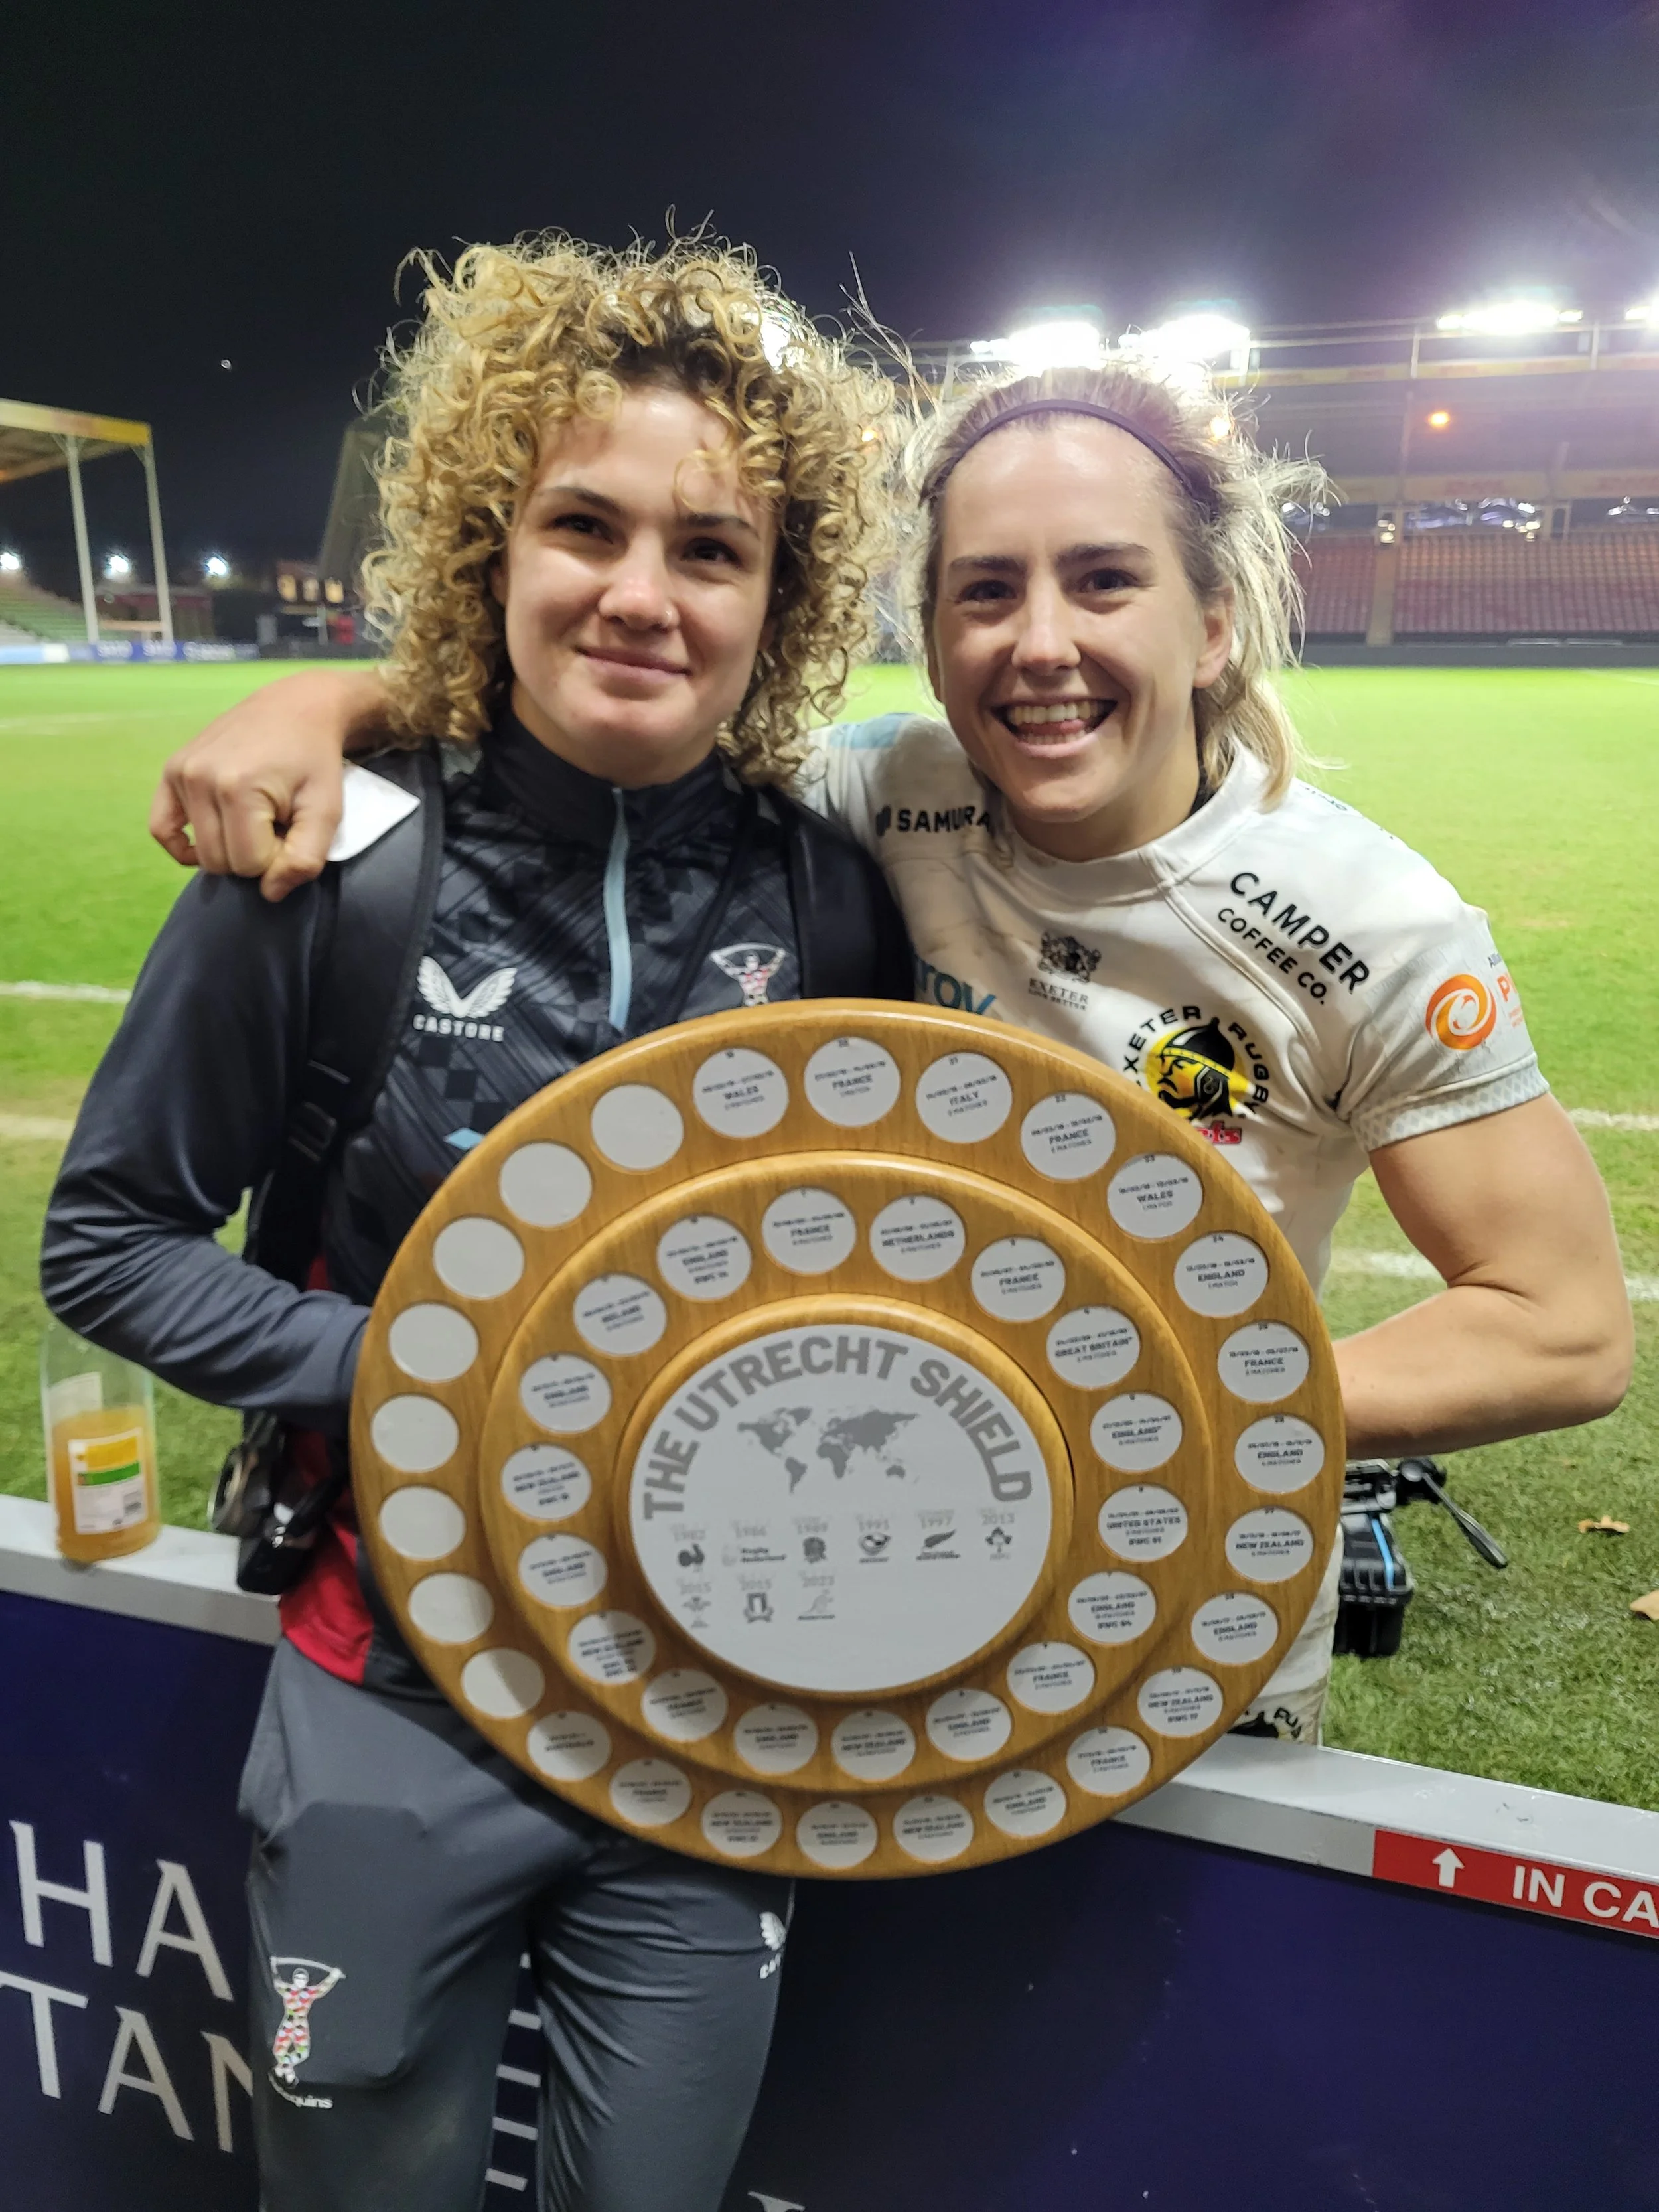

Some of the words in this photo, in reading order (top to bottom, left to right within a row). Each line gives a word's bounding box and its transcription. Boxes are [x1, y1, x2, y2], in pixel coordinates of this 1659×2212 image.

[1230, 872, 1370, 994] CAMPER
[1218, 908, 1299, 974] COFFEE
[1297, 972, 1327, 1005] CO.
[1029, 978, 1089, 1004] EXETER
[413, 1013, 504, 1042] CASTORE
[1123, 1005, 1202, 1087] XETER
[1228, 1022, 1269, 1114] RUGBY
[832, 1074, 872, 1089] FRANCE
[950, 1091, 979, 1106] ITALY
[1049, 1128, 1089, 1144] FRANCE
[1137, 1190, 1173, 1203] WALES
[999, 1273, 1039, 1286] FRANCE
[1198, 1270, 1245, 1282] ENGLAND
[1055, 1345, 1087, 1357] GREAT
[1244, 1357, 1283, 1367] FRANCE
[643, 1430, 699, 1520] THE
[674, 1335, 909, 1432] UTRECHT
[910, 1359, 1033, 1503] SHIELD
[1258, 1449, 1303, 1459] ENGLAND
[1107, 1520, 1140, 1530] UNITED
[1143, 1516, 1181, 1526] STATES
[1260, 1539, 1304, 1548] ZEALAND
[1091, 1602, 1135, 1613] ENGLAND
[1214, 1622, 1258, 1635] ENGLAND
[1148, 1700, 1169, 1708] NEW
[1171, 1694, 1213, 1706] ZEALAND
[1513, 1865, 1565, 1908] IN
